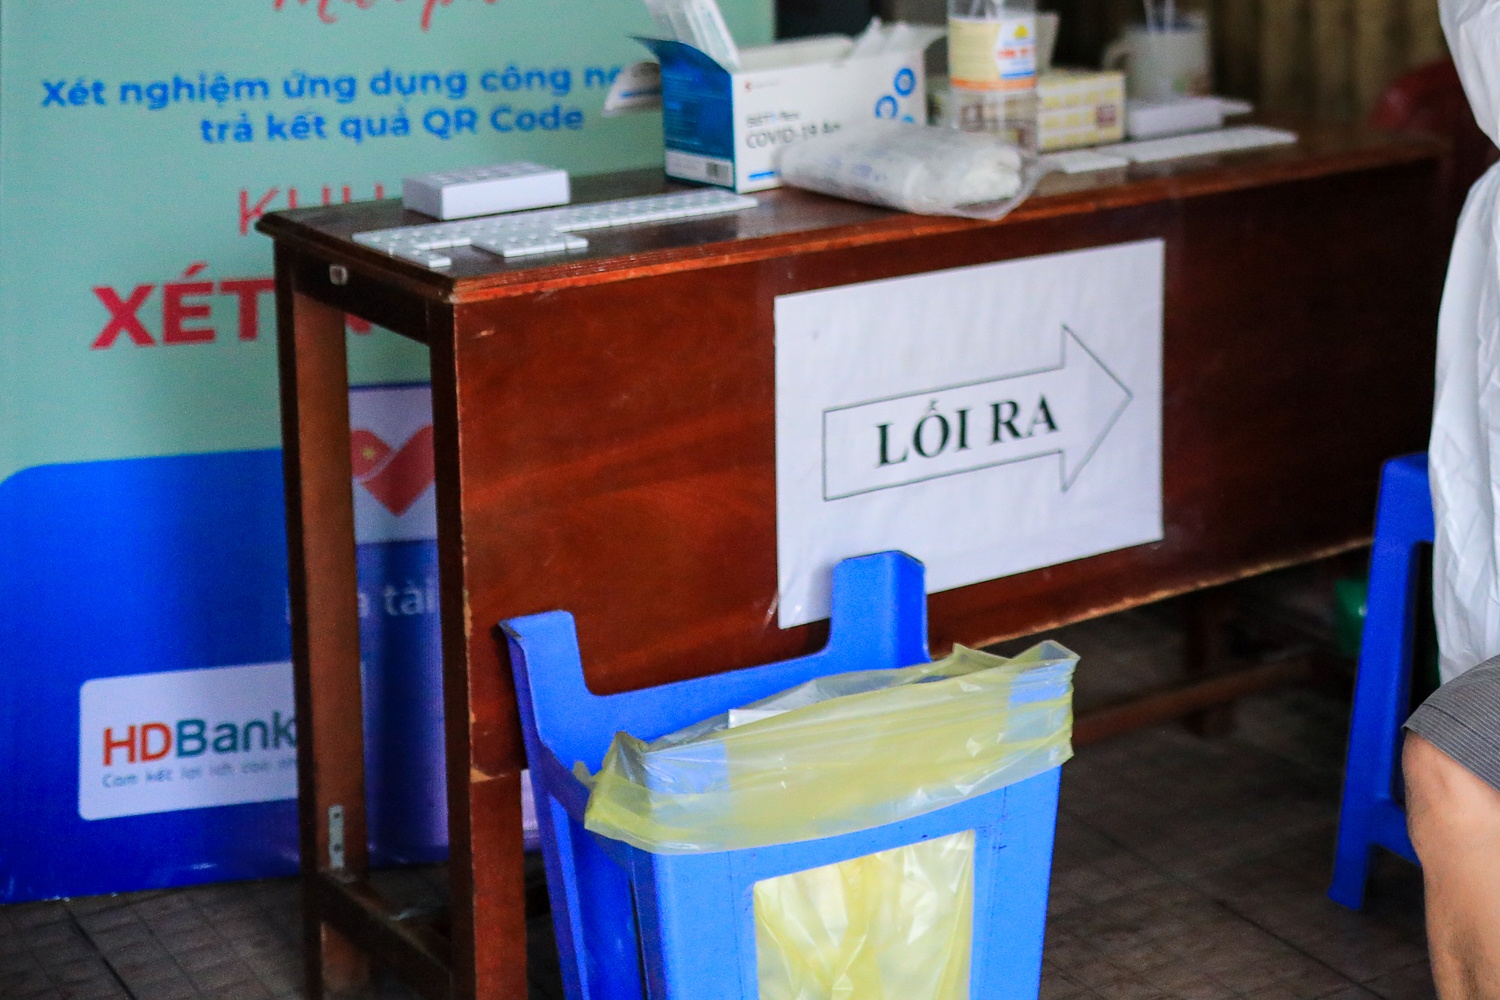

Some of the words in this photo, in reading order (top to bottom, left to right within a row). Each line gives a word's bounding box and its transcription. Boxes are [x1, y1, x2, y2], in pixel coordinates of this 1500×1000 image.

[41, 77, 106, 108] Xét
[119, 71, 271, 111] nghiệm
[282, 68, 357, 104] ứng
[369, 65, 468, 101] dụng
[480, 64, 571, 97] công
[200, 111, 254, 144] trả
[266, 106, 327, 141] kết
[339, 104, 410, 145] quả
[422, 107, 477, 140] QR
[489, 104, 585, 133] Code
[90, 259, 276, 351] XÉT
[874, 398, 970, 469] LỐI
[989, 393, 1060, 447] RA
[103, 711, 297, 767] HDBank
